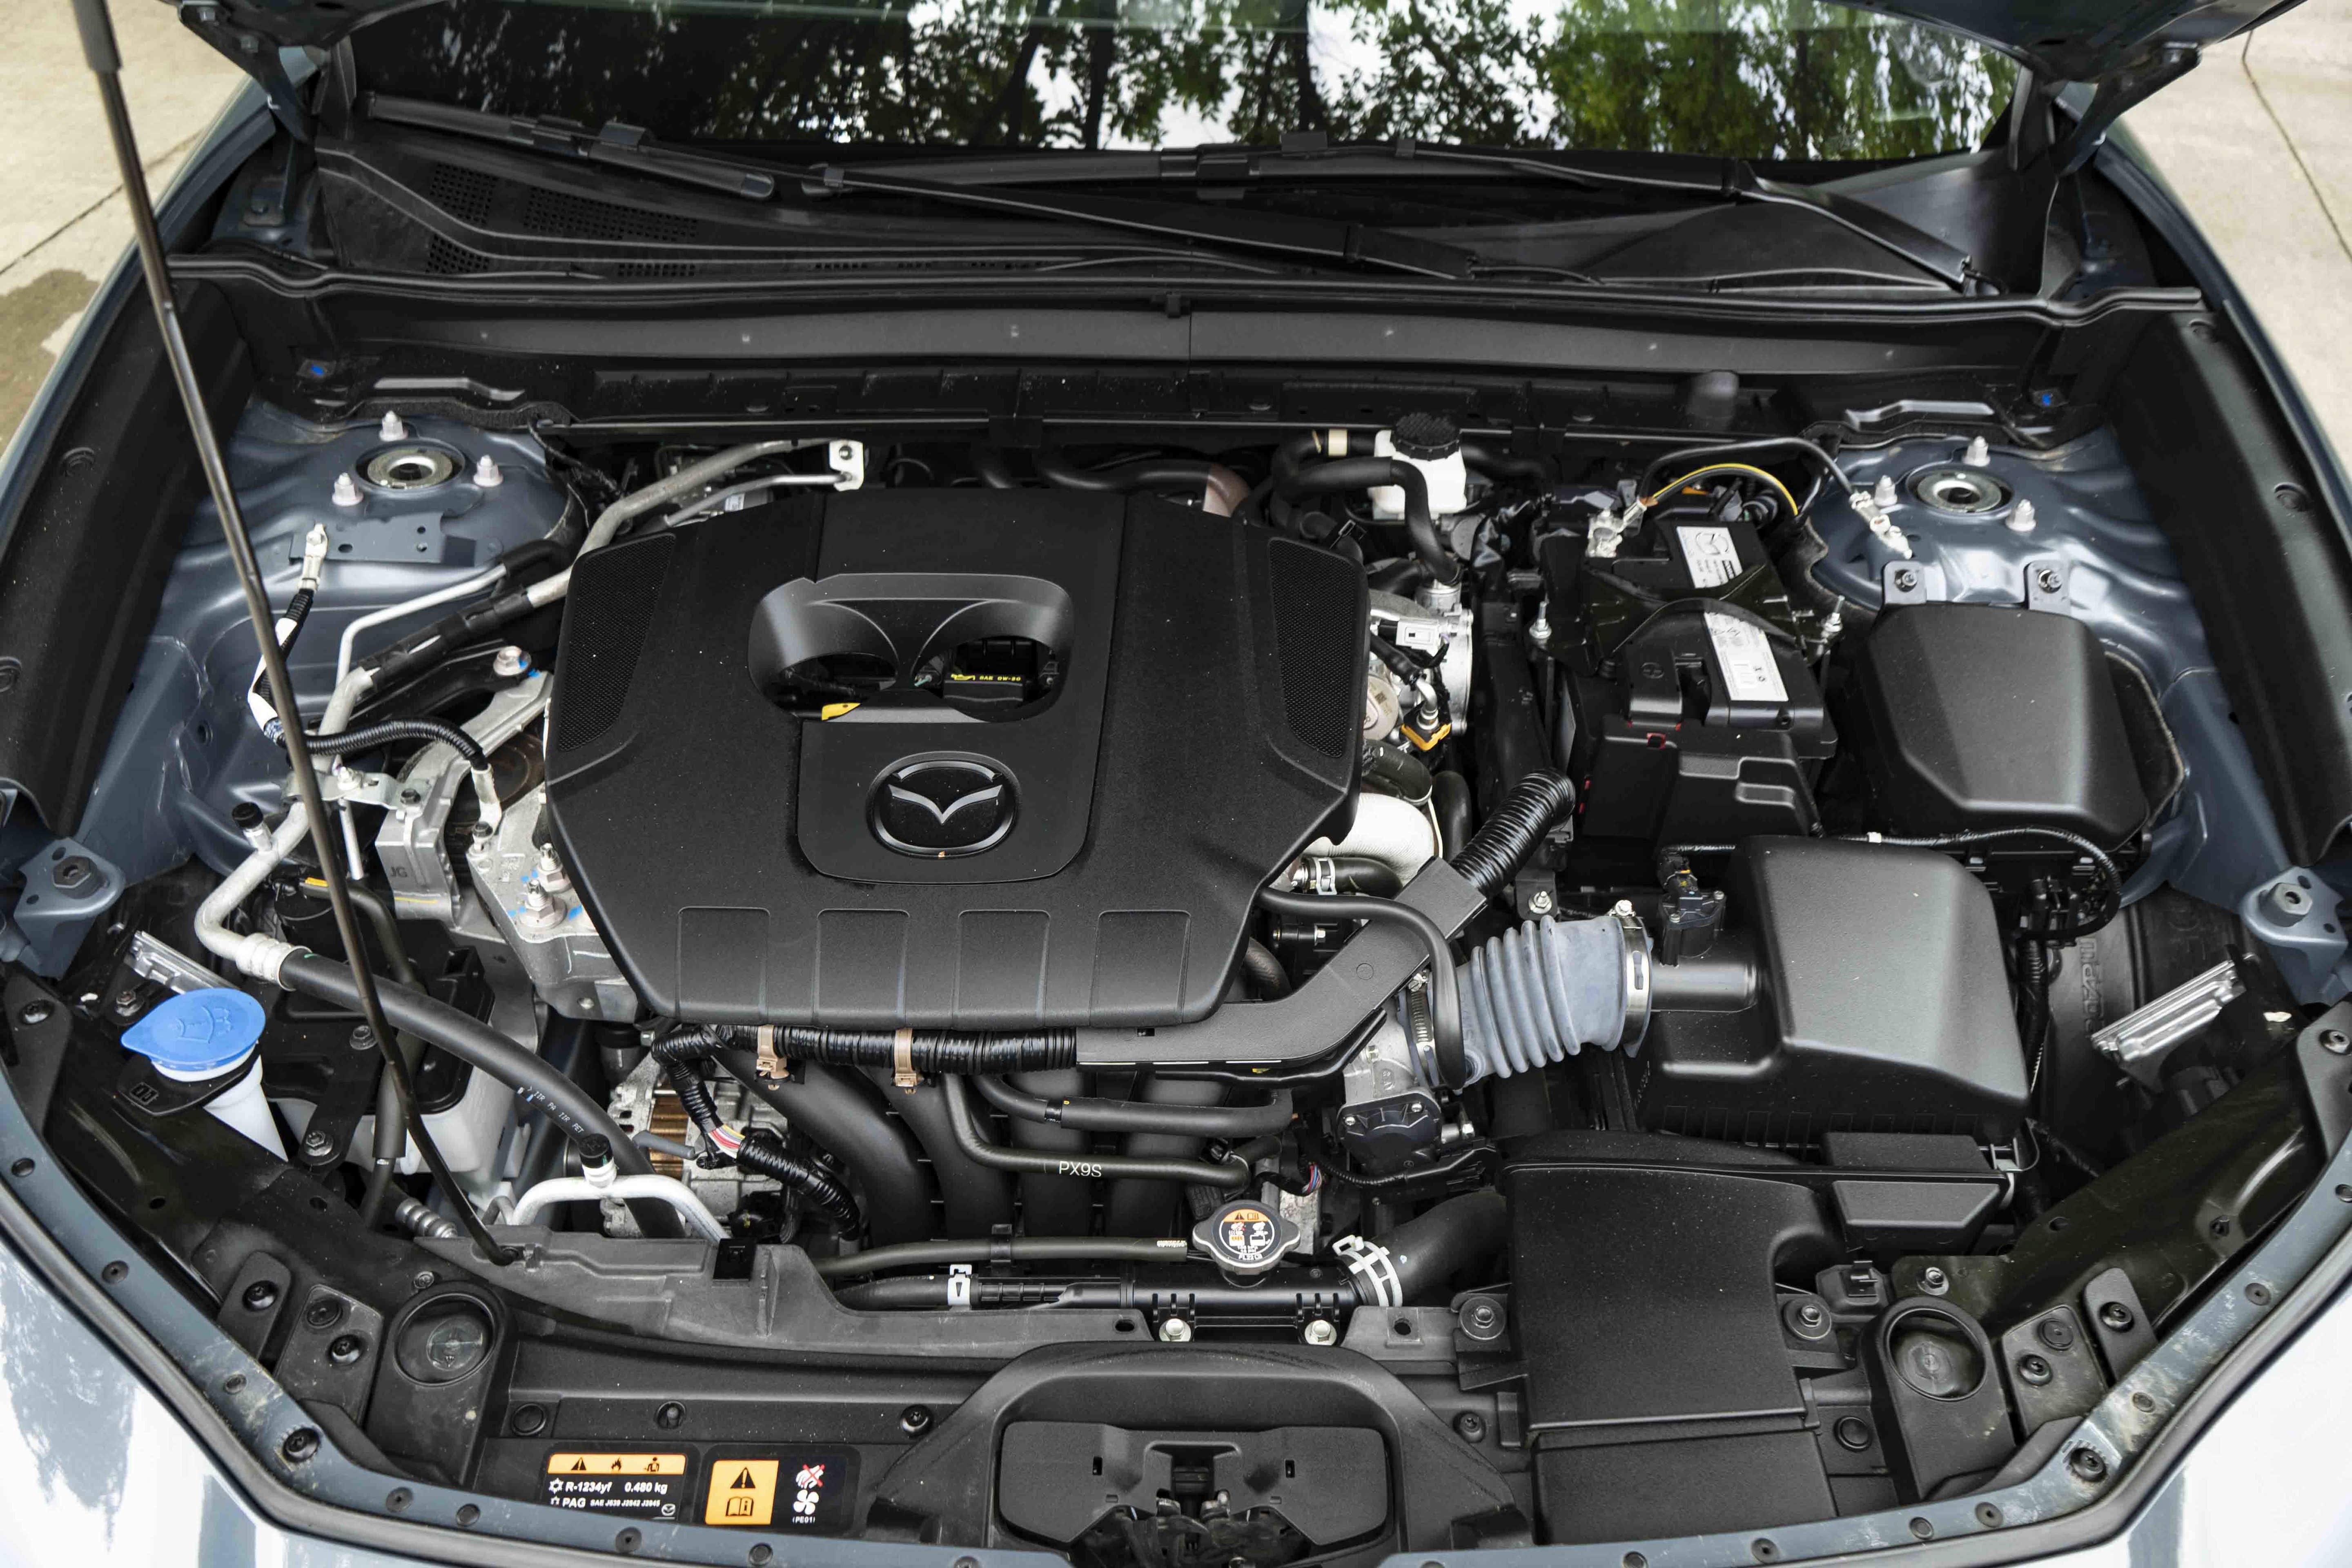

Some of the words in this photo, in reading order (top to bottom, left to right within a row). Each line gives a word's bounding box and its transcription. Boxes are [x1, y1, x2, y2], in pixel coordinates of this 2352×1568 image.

[572, 1123, 585, 1134] PET
[1059, 1160, 1102, 1177] PX9S
[565, 1481, 613, 1494] R-1234yf
[654, 1482, 668, 1494] kg
[562, 1497, 586, 1508] PAG
[590, 1499, 604, 1507] SAE
